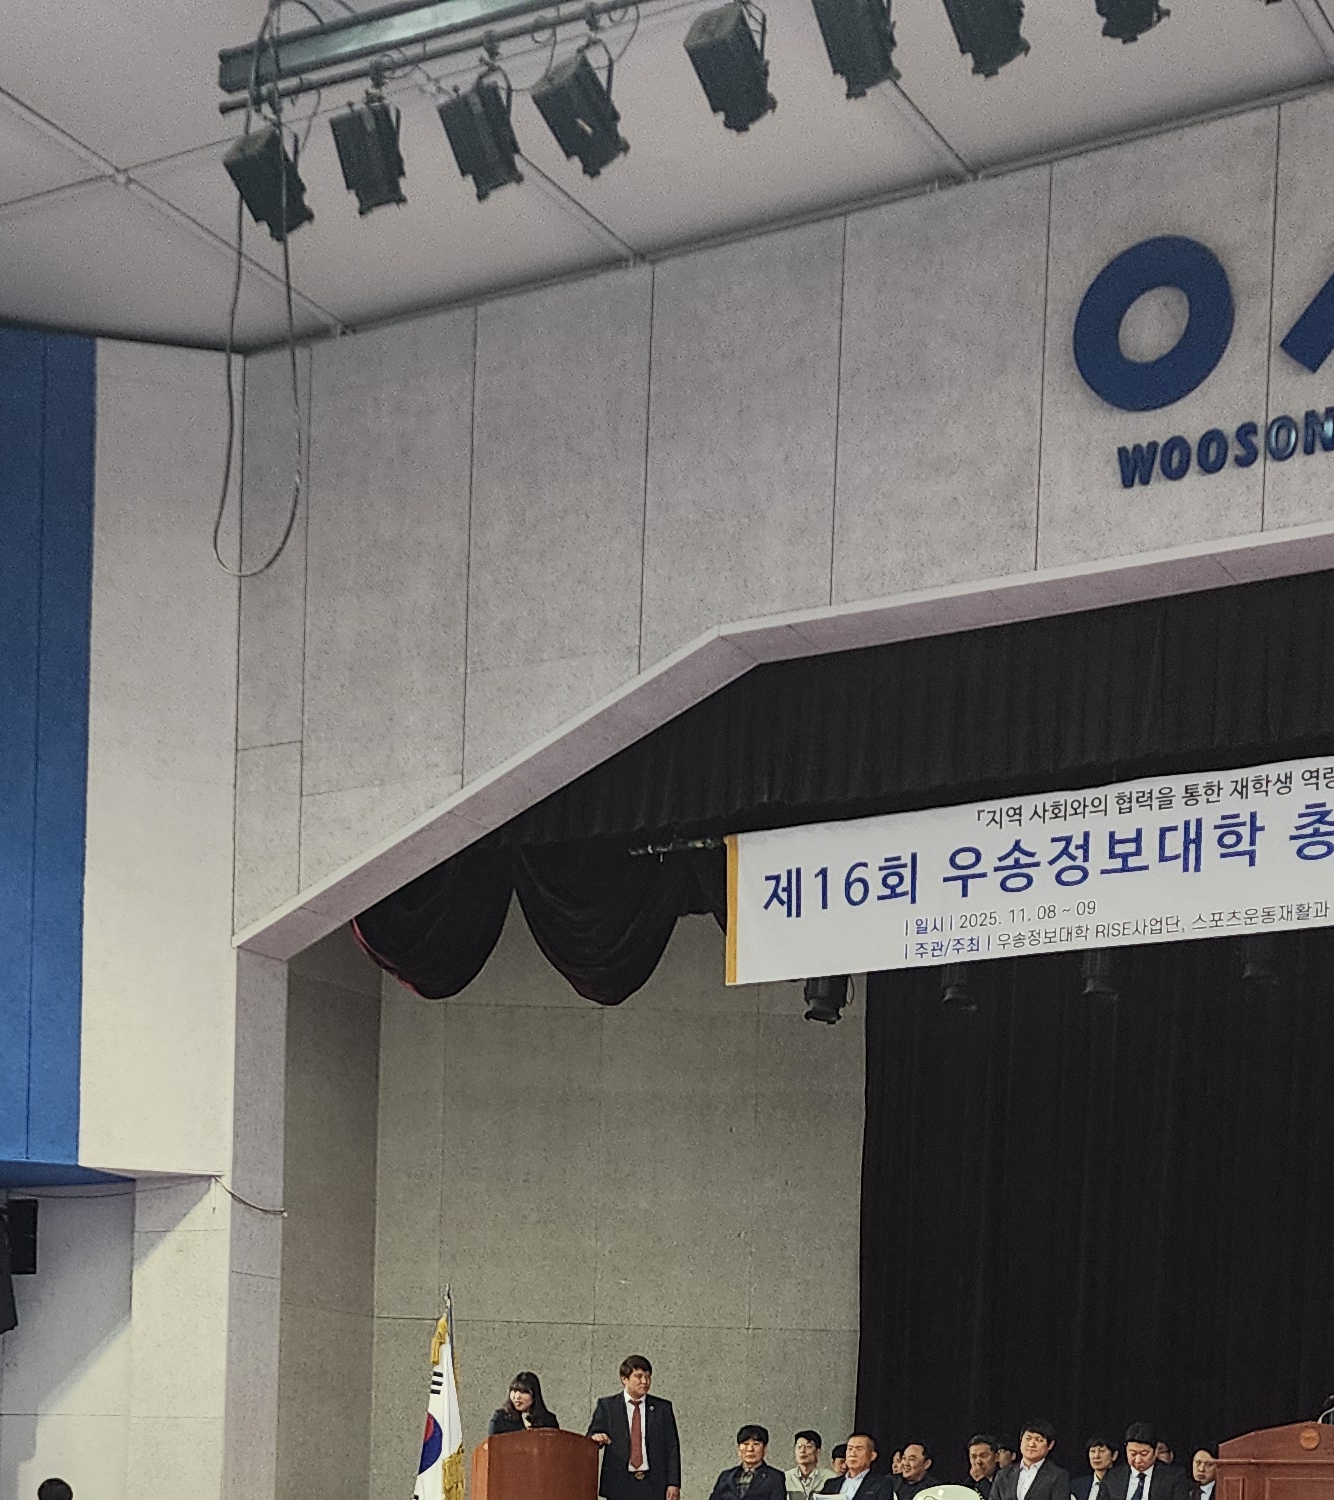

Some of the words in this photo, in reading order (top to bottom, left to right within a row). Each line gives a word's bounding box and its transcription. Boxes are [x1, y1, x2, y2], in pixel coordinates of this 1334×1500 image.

[1029, 794, 1109, 825] 사회와의
[1115, 785, 1176, 815] 협력을
[1182, 780, 1223, 807] 통한
[1229, 770, 1294, 800] 재학생
[763, 852, 917, 919] 제16회
[942, 810, 1266, 898] 우송정보대학
[915, 916, 945, 935] 일시
[959, 911, 1003, 929] 2025.
[1009, 907, 1032, 924] 11.
[1037, 903, 1057, 920] 08
[1076, 900, 1097, 917] 09
[915, 936, 981, 960] 주관/주최
[997, 924, 1090, 950] 우송정보대학
[1192, 900, 1331, 931] 스포츠운동재활과
